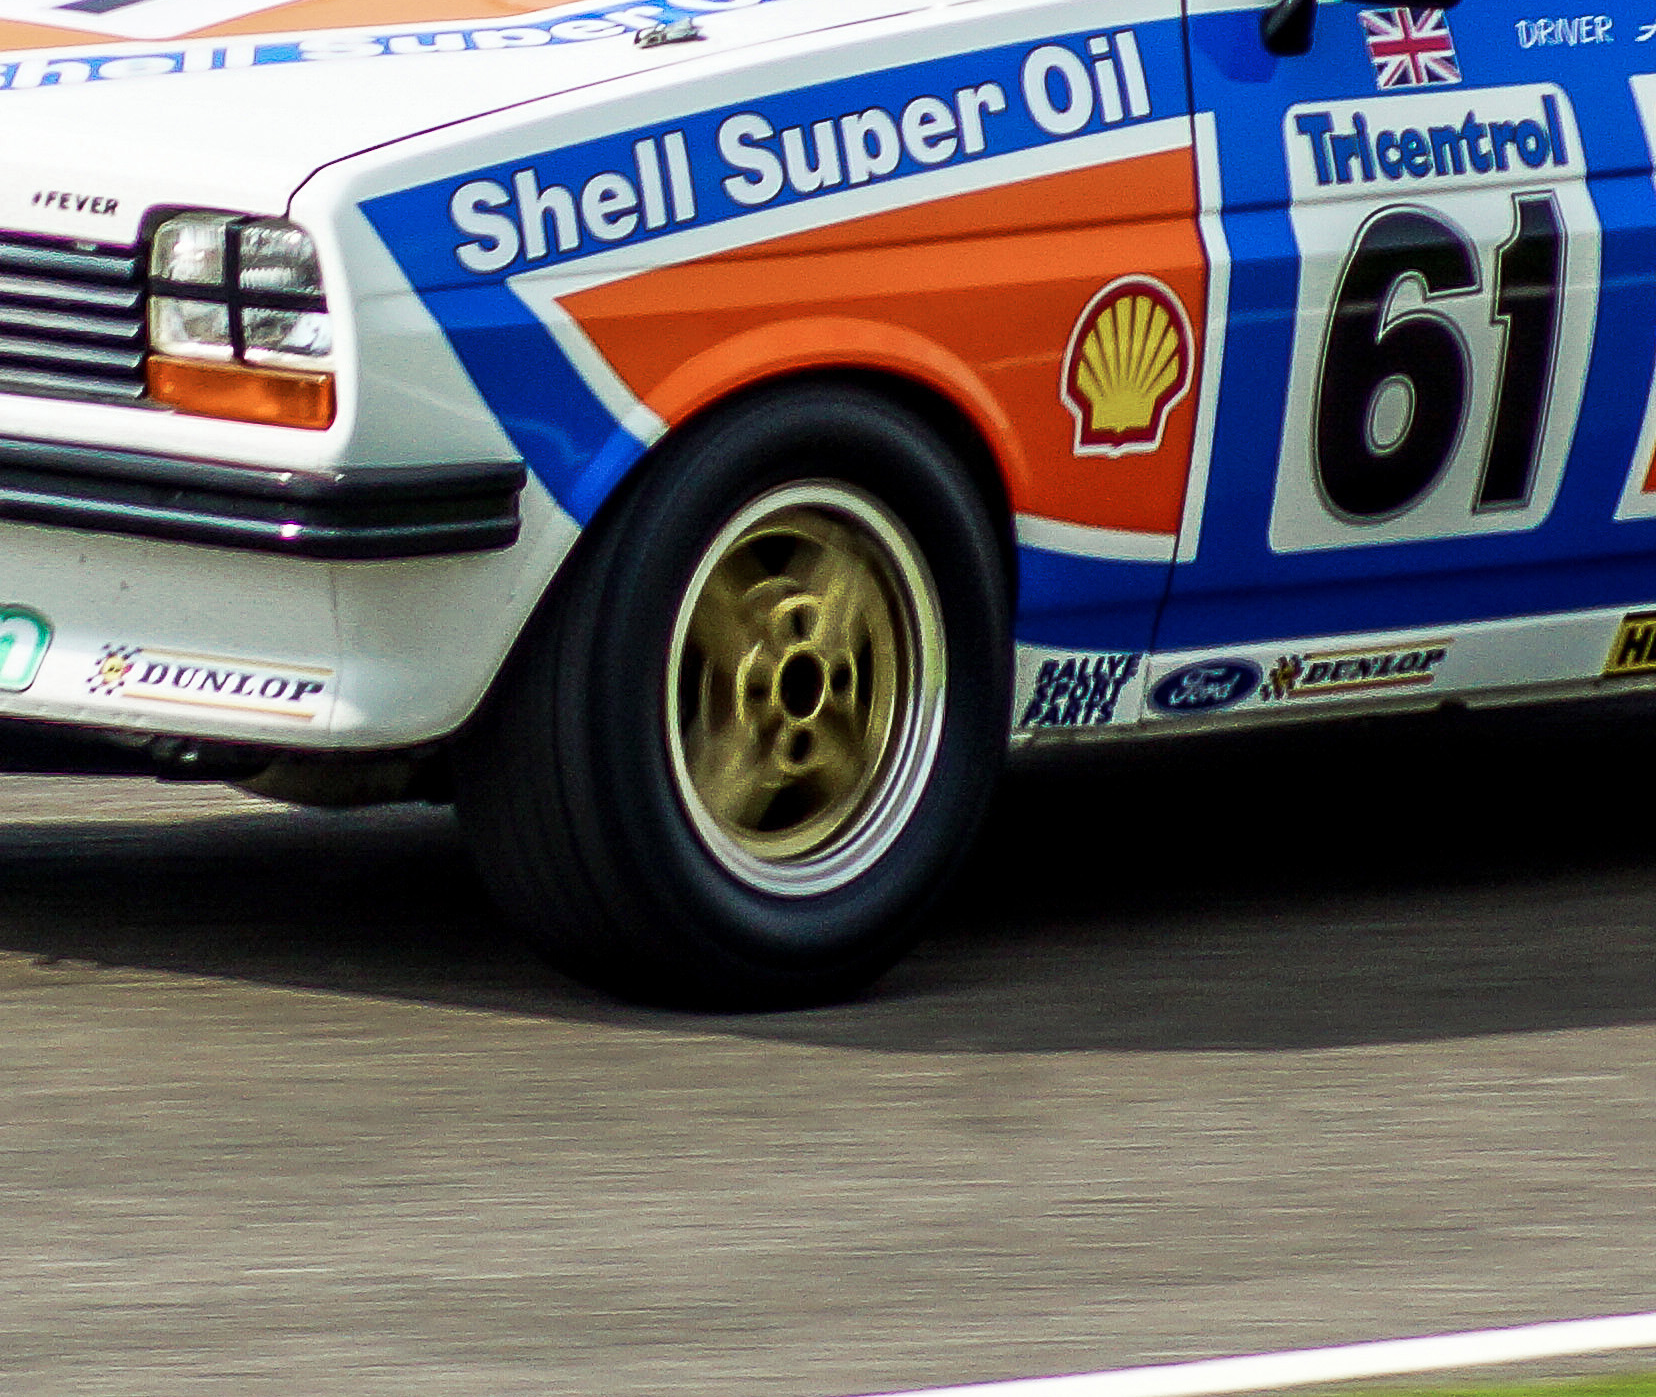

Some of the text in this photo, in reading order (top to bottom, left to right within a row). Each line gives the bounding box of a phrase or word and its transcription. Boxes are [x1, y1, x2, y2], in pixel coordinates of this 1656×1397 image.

[1514, 14, 1614, 49] DRIVER
[449, 29, 1153, 274] Shell Super Oil
[1296, 93, 1570, 186] Tricentrol
[1310, 189, 1570, 528] 61
[137, 661, 326, 702] DUNLOP
[1301, 647, 1446, 684] DUNLOP
[1034, 677, 1127, 704] SPORT
[1167, 666, 1242, 705] Ford
[1020, 699, 1114, 728] PARTS
